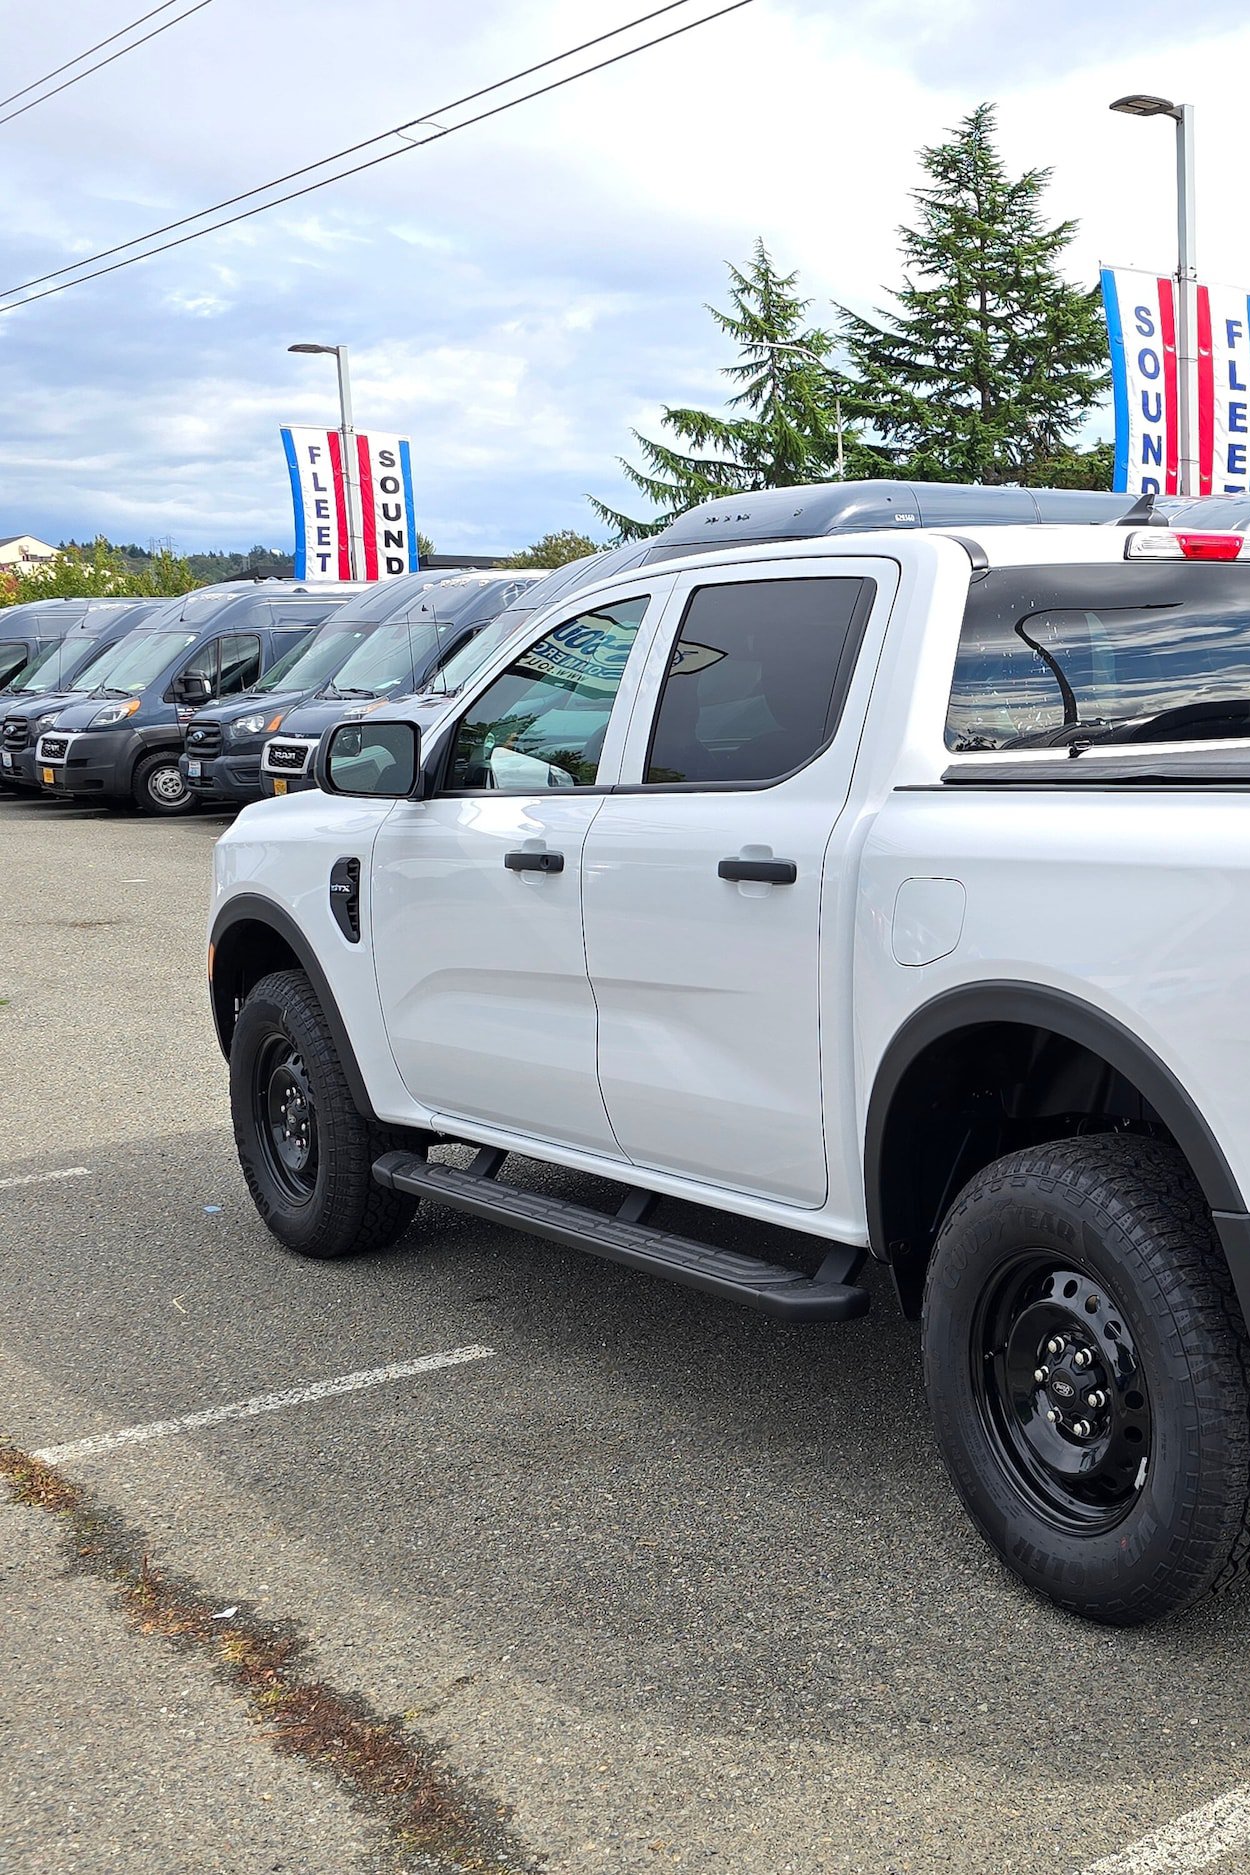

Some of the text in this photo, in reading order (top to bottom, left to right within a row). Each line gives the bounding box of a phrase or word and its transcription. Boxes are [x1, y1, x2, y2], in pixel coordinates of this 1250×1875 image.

[1224, 319, 1248, 493] FLEE
[308, 446, 331, 572] FLEET
[379, 450, 404, 574] SOUND
[274, 751, 296, 760] RAM
[331, 884, 350, 892] STX
[942, 1204, 1076, 1289] GOODYEAR
